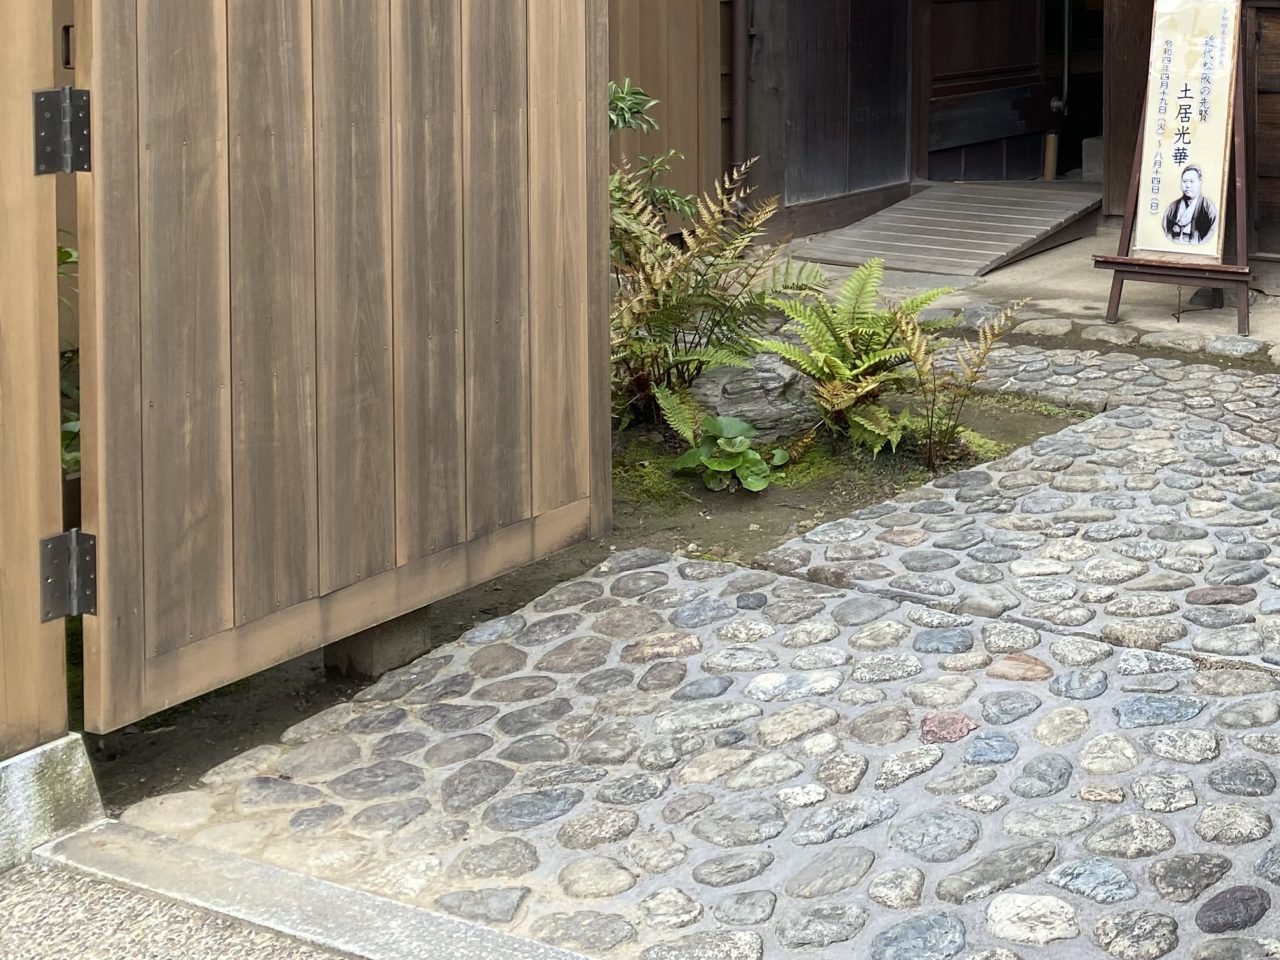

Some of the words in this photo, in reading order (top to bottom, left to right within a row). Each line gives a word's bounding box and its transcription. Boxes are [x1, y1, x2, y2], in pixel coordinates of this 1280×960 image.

[1198, 35, 1216, 123] 近代松阪の先賢
[1172, 82, 1195, 166] 土居光華
